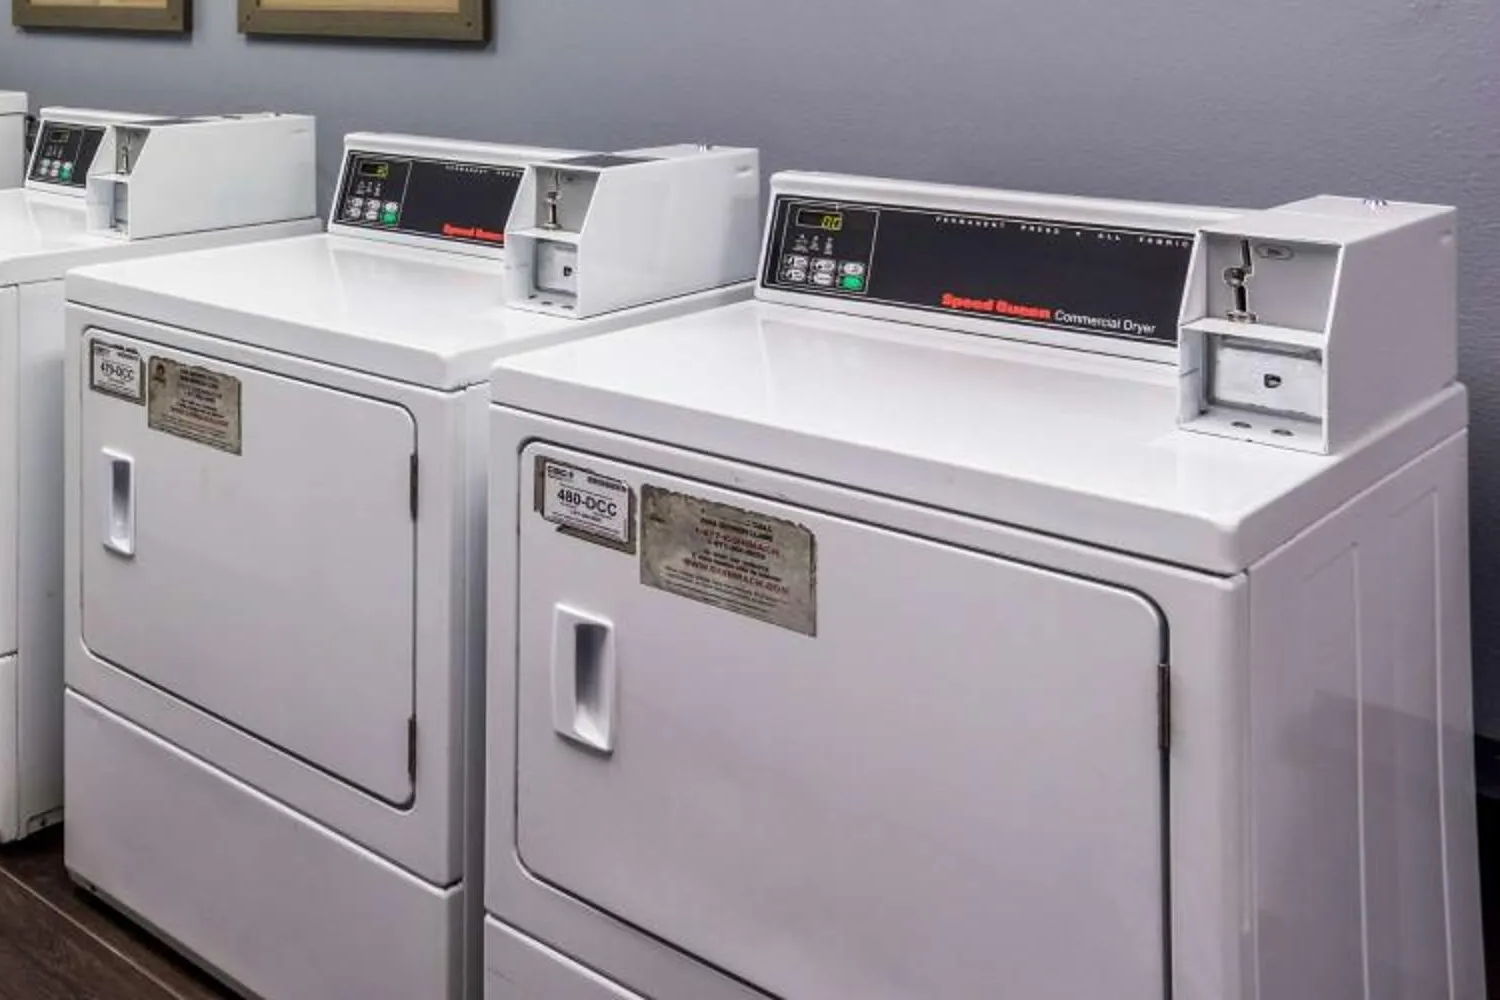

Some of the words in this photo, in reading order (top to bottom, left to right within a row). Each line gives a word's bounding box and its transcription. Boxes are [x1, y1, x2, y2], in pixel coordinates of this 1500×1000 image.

[941, 292, 995, 312] Speed
[995, 300, 1052, 320] Queen
[1054, 308, 1122, 330] Commercial
[1122, 318, 1157, 335] Dryer
